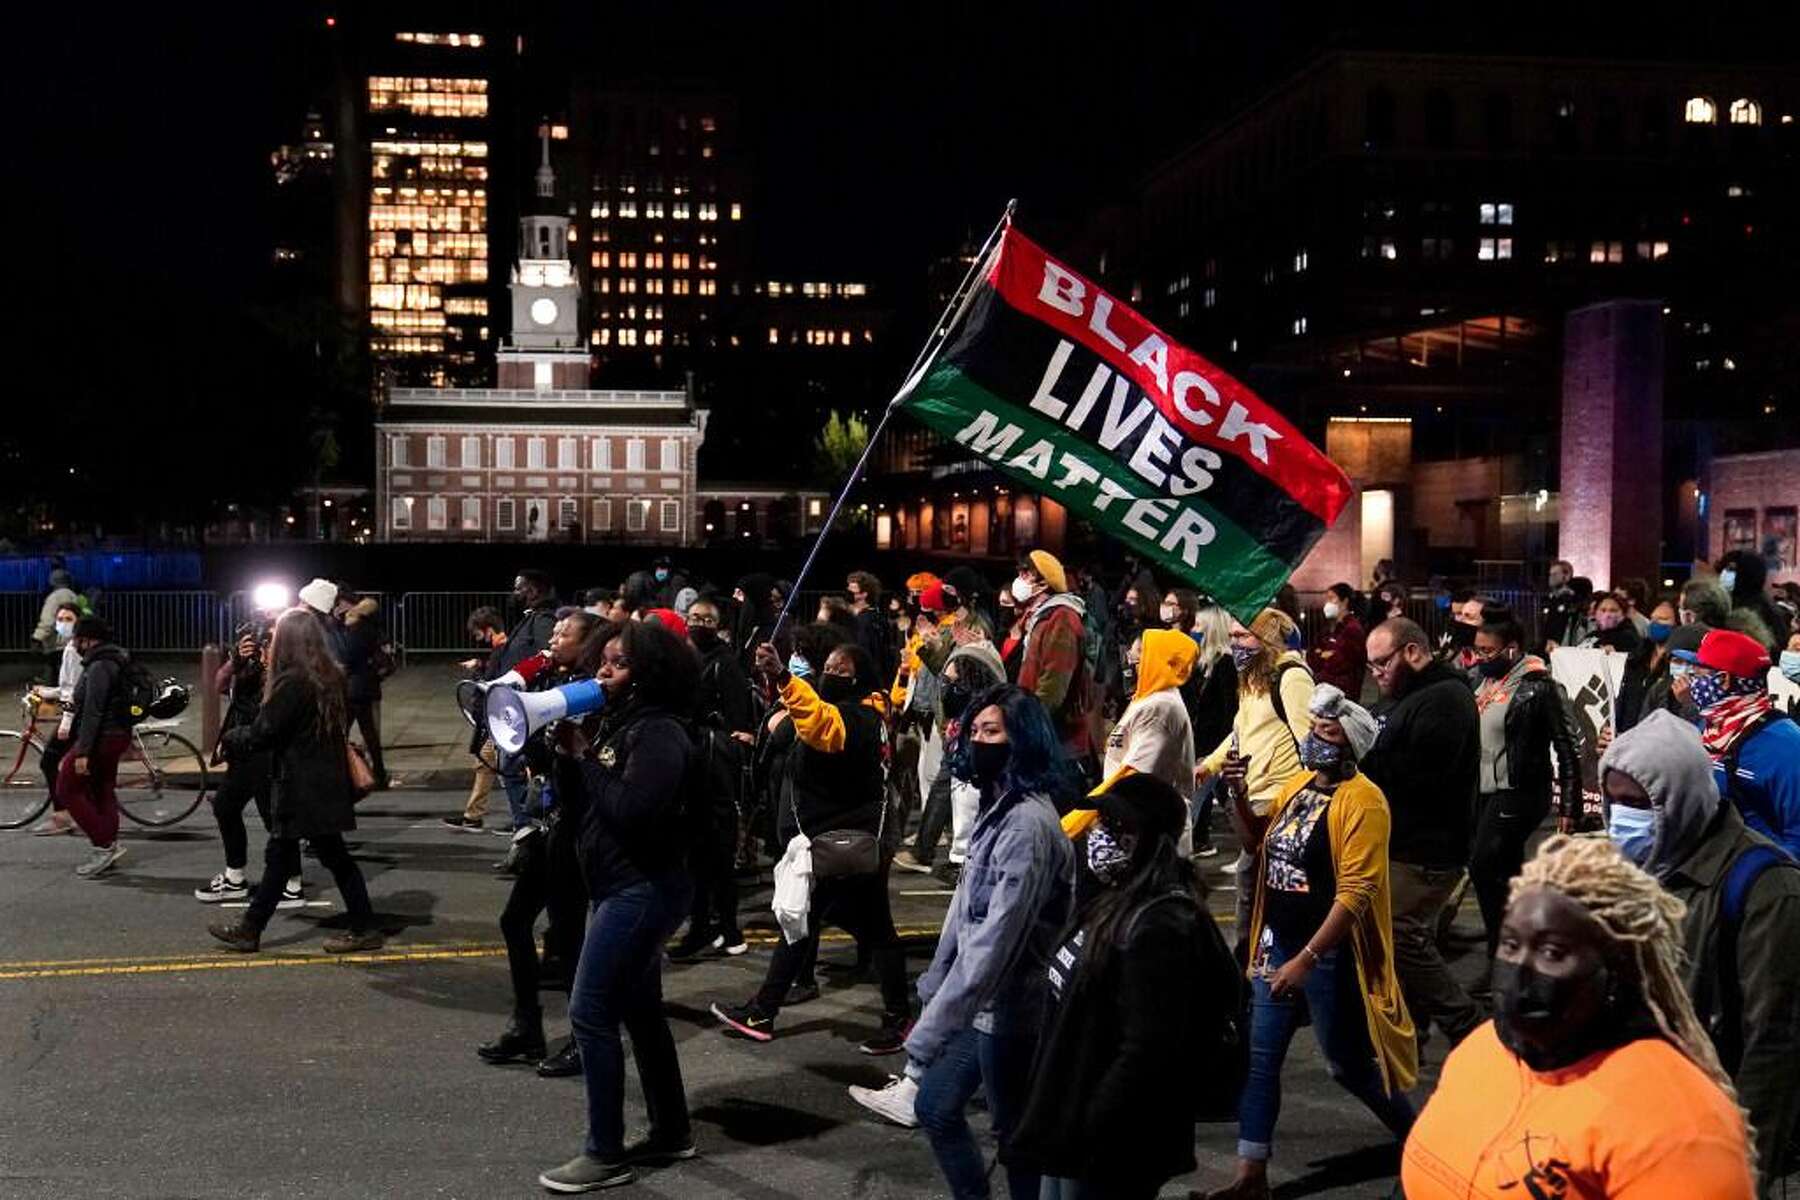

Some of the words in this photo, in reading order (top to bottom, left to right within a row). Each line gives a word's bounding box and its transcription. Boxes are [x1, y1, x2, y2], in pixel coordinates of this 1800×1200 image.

[1029, 338, 1222, 496] LIVES
[1037, 260, 1284, 465] BLACK
[954, 409, 1217, 569] MATTER
